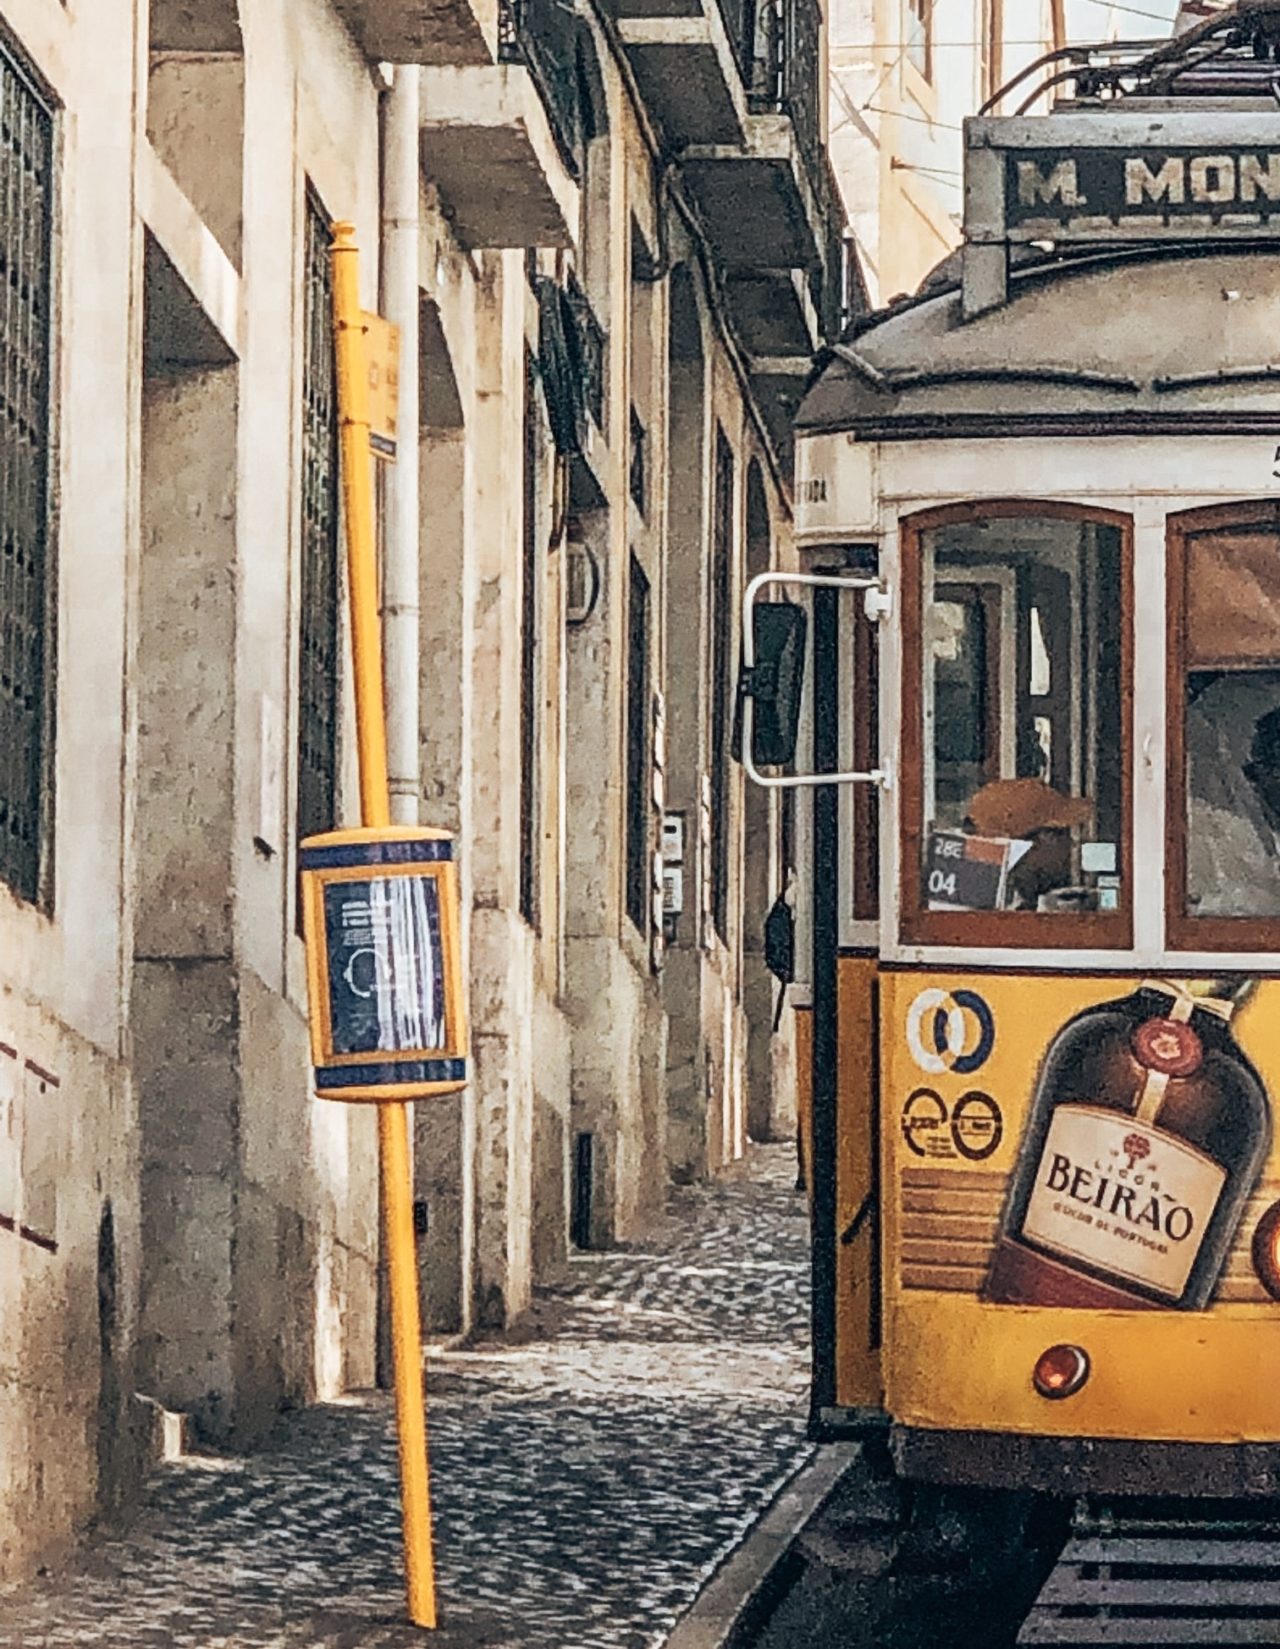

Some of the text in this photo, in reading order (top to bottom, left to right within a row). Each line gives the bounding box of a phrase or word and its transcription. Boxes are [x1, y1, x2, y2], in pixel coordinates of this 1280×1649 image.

[1016, 158, 1087, 206] M.
[928, 870, 956, 896] 04
[1094, 1160, 1160, 1192] LICOR
[1046, 1153, 1194, 1242] BEIRÃO
